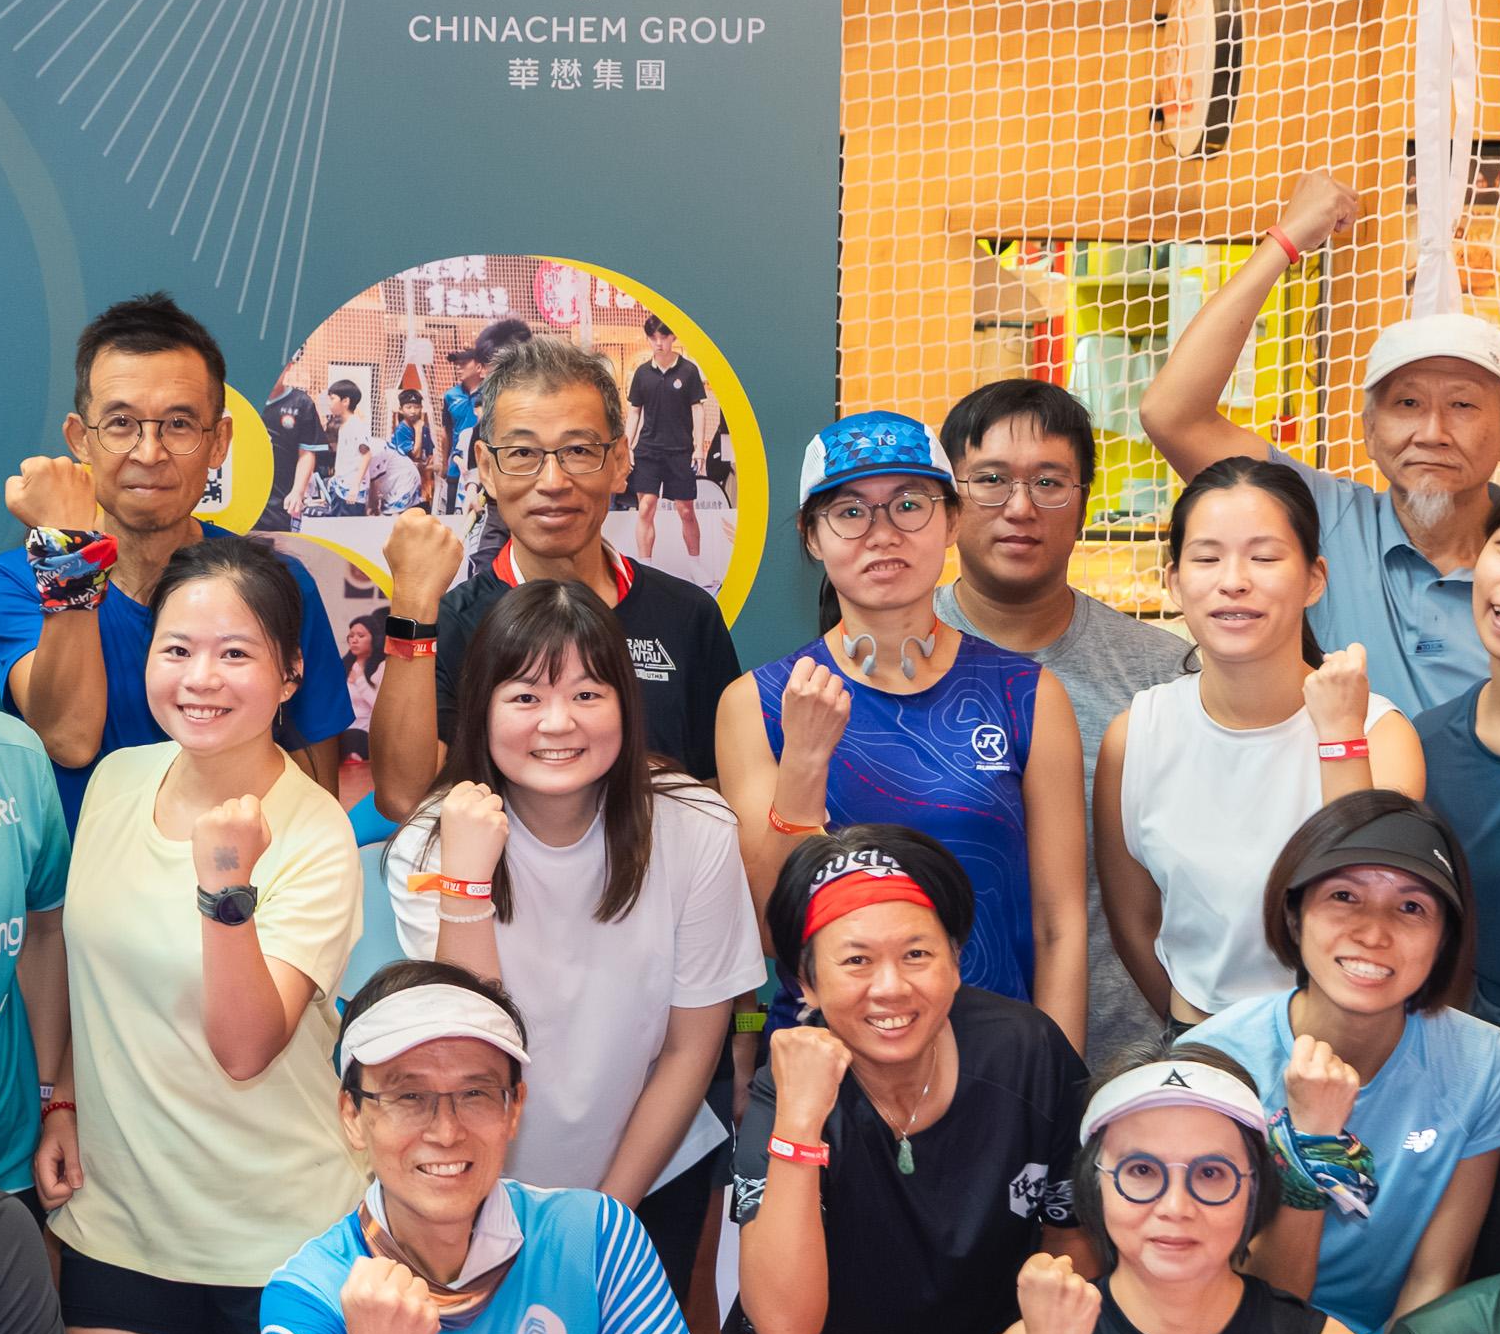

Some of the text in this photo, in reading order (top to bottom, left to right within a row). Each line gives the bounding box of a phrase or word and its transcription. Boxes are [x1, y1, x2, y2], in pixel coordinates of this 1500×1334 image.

[408, 13, 767, 46] CHINACHEM GROUP
[507, 57, 666, 92] 華懋集團
[875, 433, 898, 447] T8
